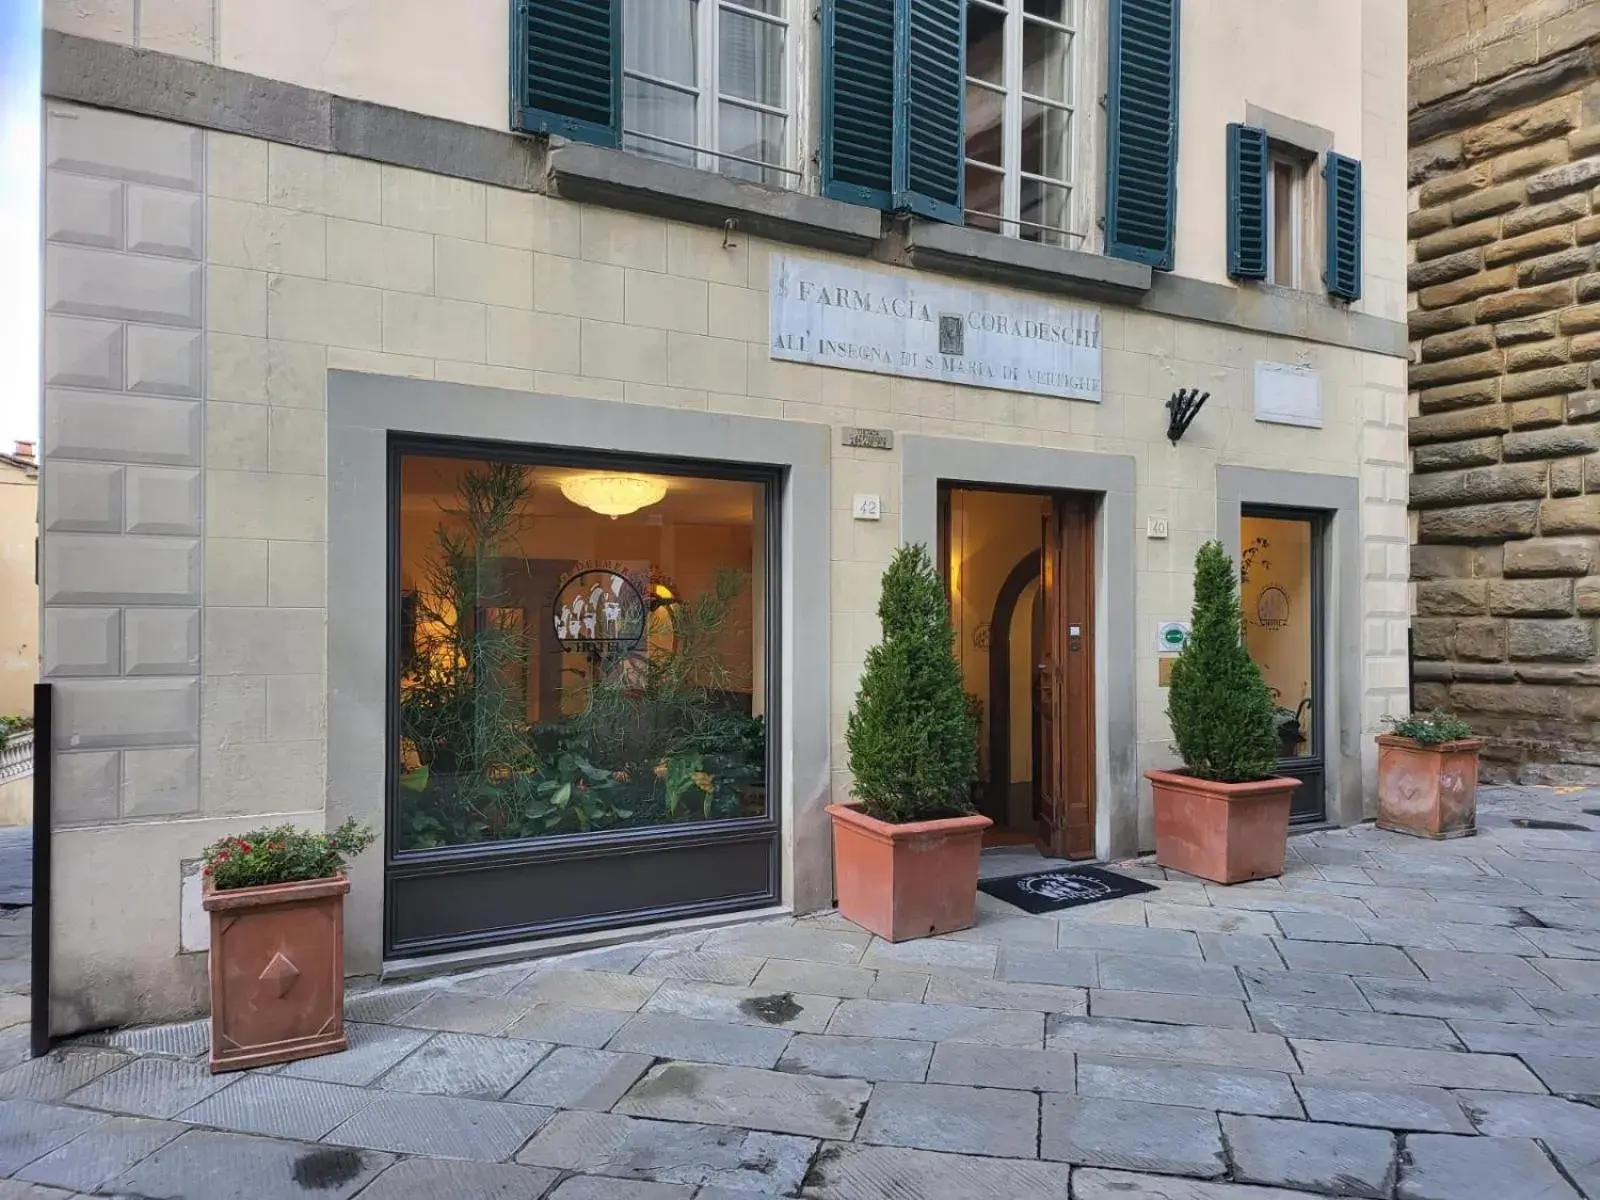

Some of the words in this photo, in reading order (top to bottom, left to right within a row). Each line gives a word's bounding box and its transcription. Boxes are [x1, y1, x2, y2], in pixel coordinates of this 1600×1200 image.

[799, 280, 935, 322] FARMACIA
[968, 311, 1099, 348] CORADESCHI
[775, 330, 811, 352] ALL'
[820, 339, 891, 364] INSEGNA
[902, 351, 919, 367] DI
[942, 357, 993, 378] MARIA
[1003, 366, 1019, 381] DI
[1152, 521, 1165, 534] 40
